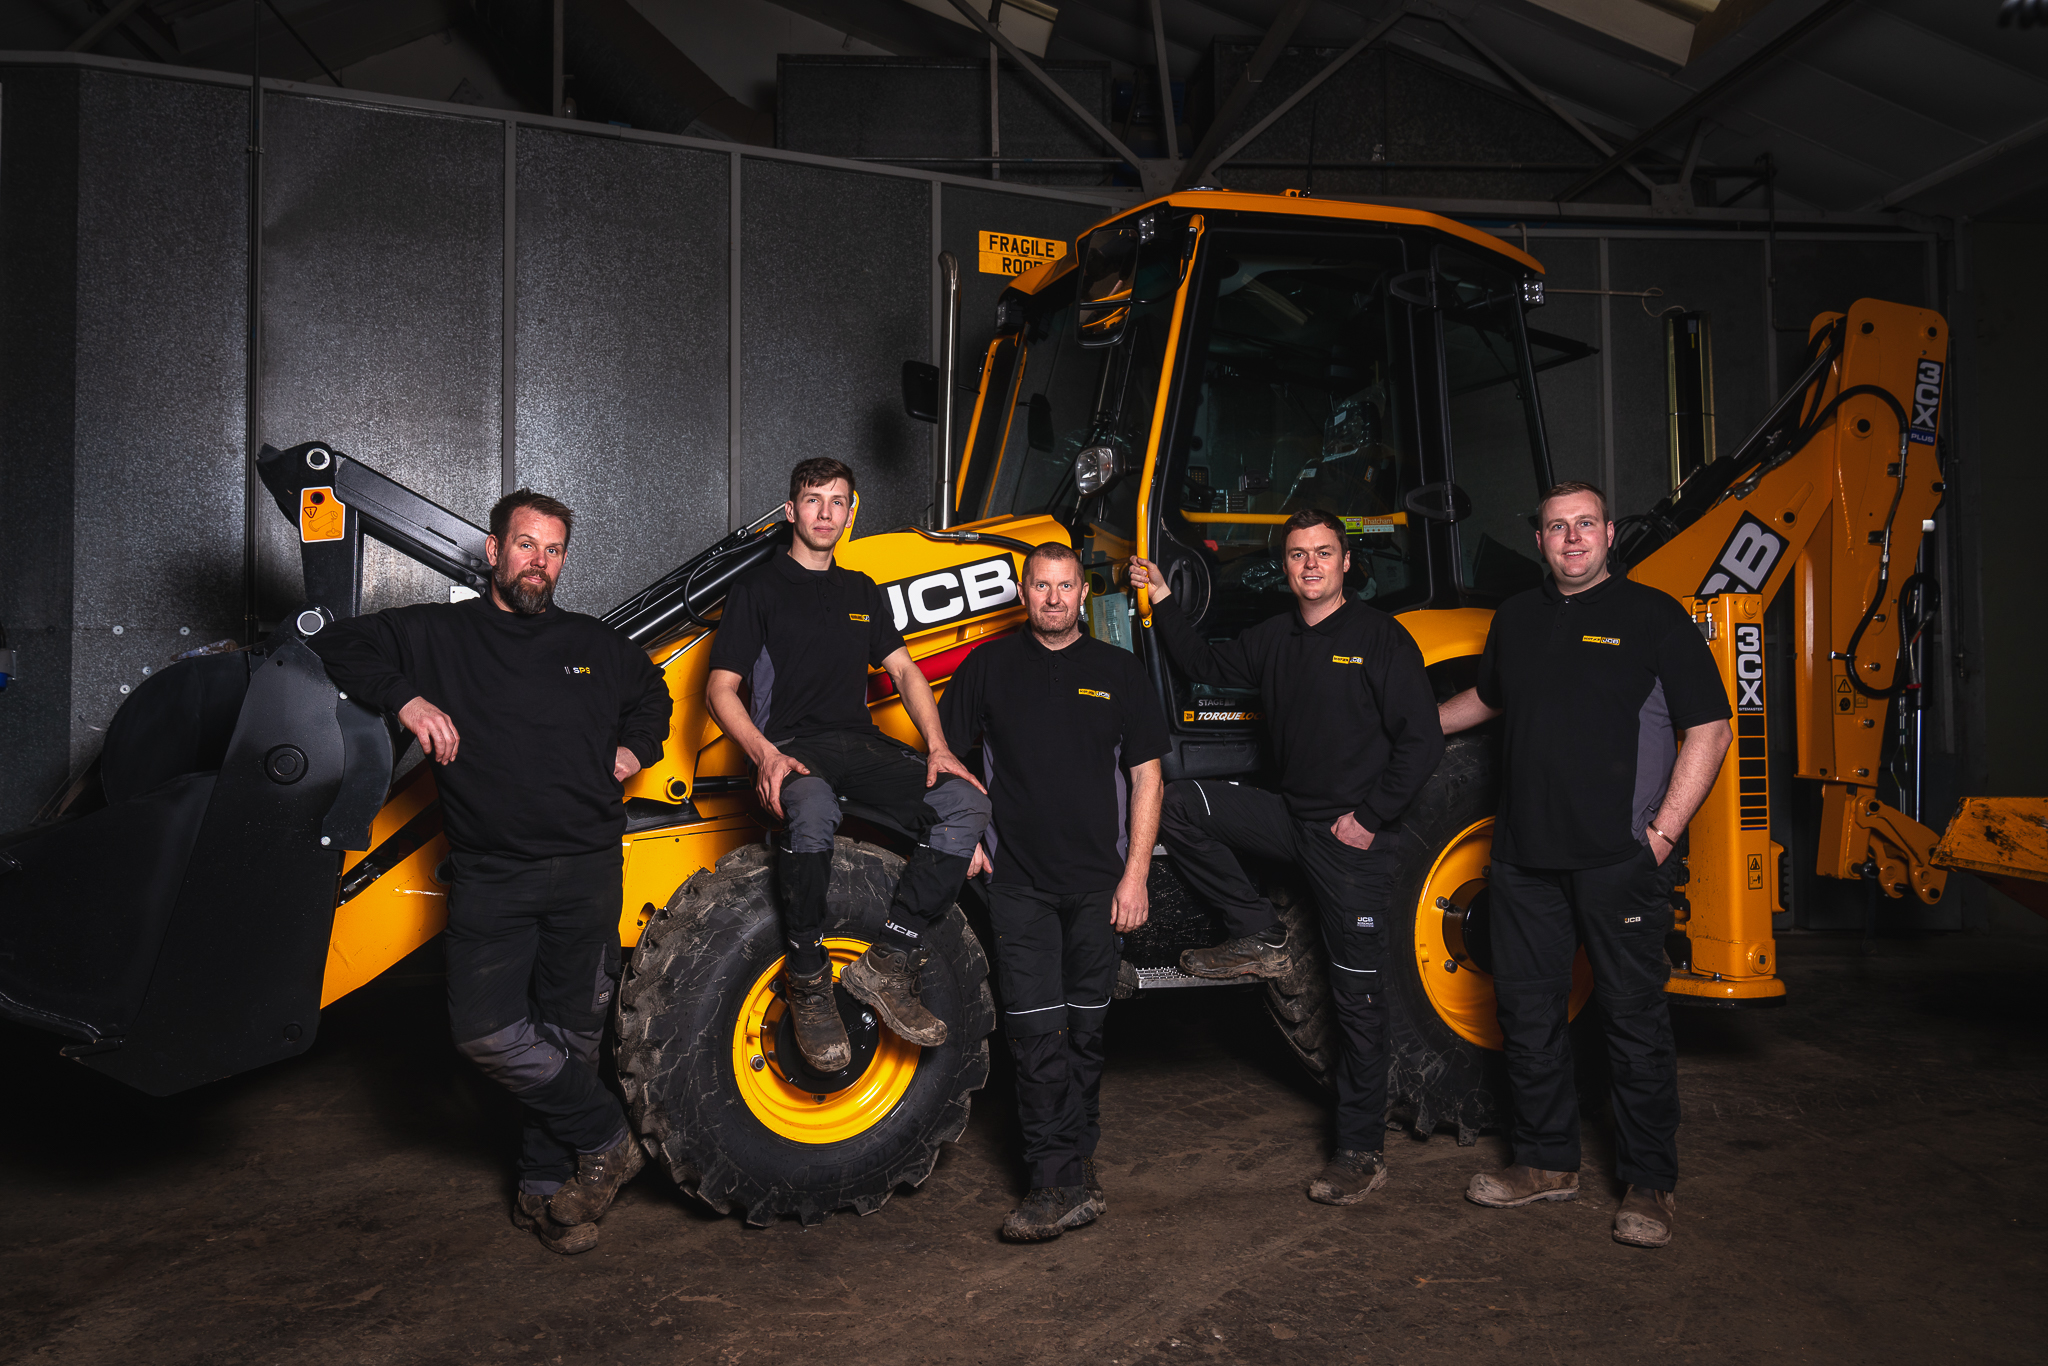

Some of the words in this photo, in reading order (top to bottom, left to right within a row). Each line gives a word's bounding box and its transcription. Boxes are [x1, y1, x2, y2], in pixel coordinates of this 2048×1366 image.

[990, 234, 1055, 258] FRAGILE
[1912, 361, 1941, 428] 3CX
[1910, 433, 1934, 443] PLUS
[1364, 517, 1393, 525] Thatcham
[887, 559, 1017, 632] JCB
[1737, 626, 1763, 706] 3CX
[885, 921, 918, 939] JCB
